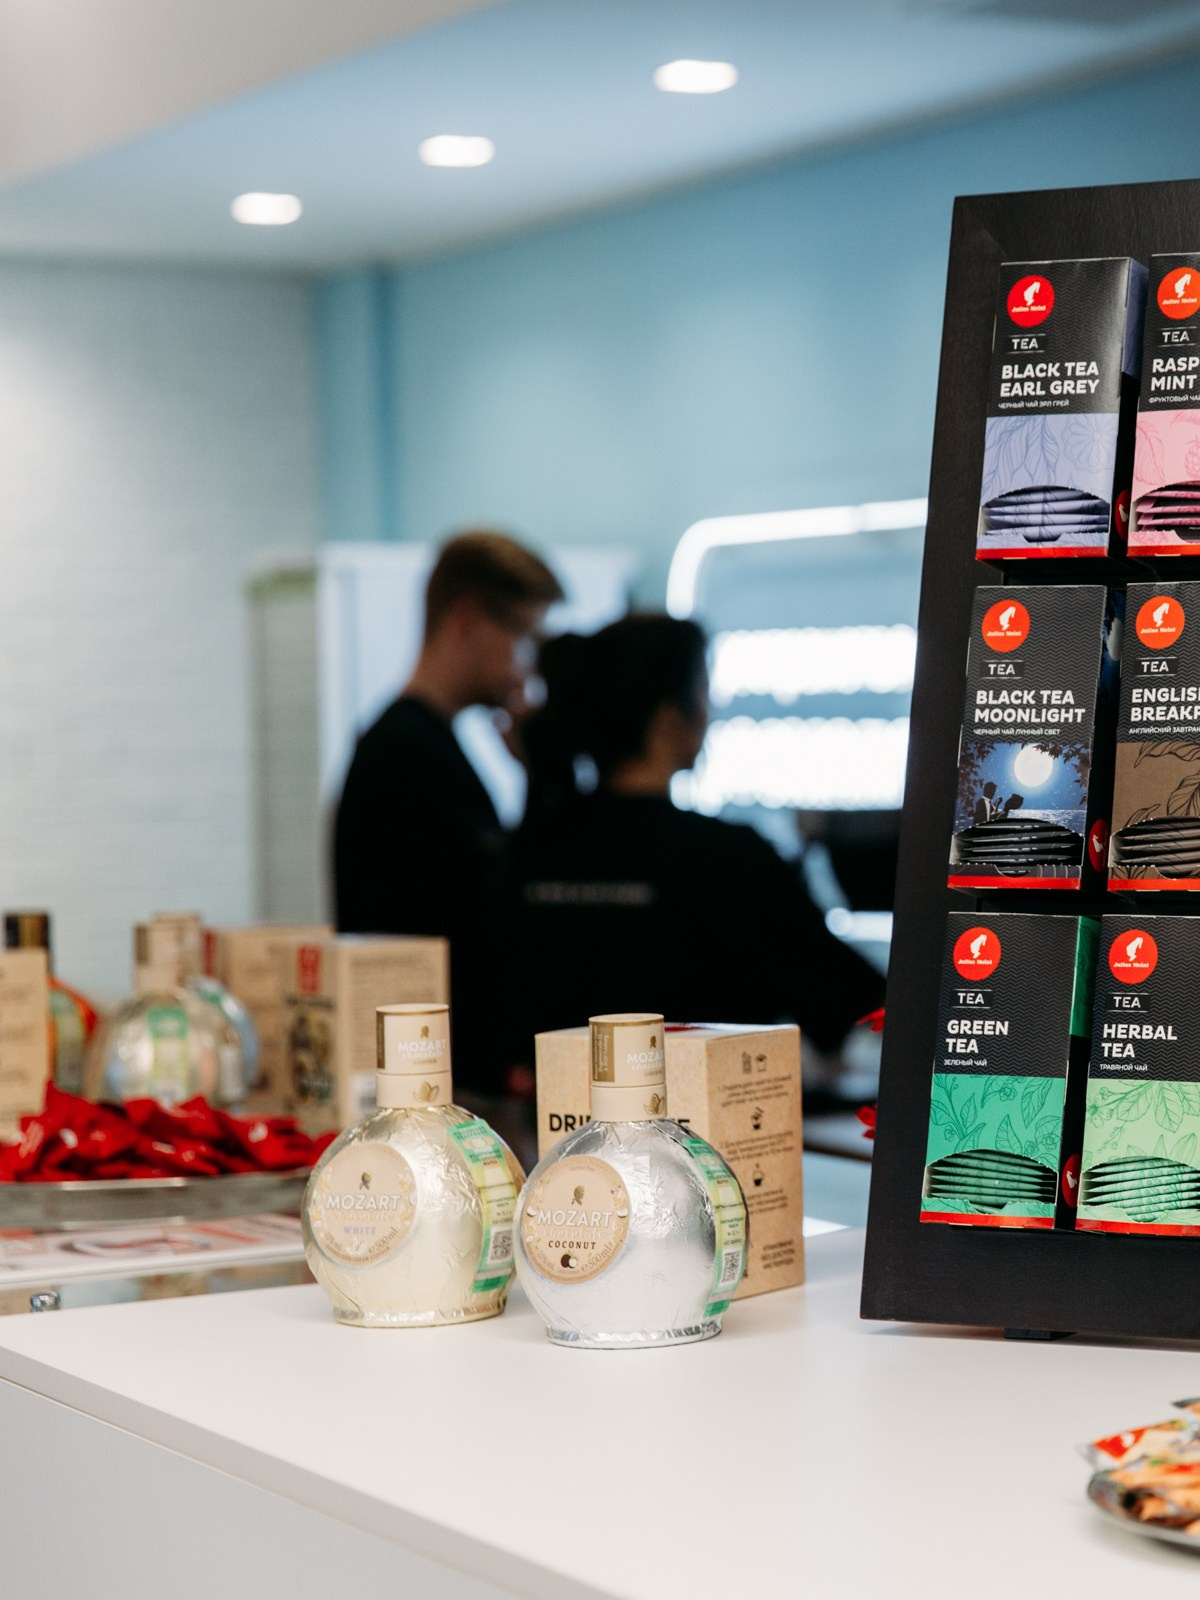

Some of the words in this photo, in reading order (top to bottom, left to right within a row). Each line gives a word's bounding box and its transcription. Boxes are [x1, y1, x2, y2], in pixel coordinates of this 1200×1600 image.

[1162, 331, 1190, 343] TEA
[1012, 338, 1039, 350] TEA
[1001, 362, 1061, 379] BLACK
[1064, 361, 1099, 376] TEA
[1000, 380, 1046, 397] EARL
[1049, 379, 1100, 394] GREY
[1151, 375, 1197, 391] MINT
[998, 401, 1025, 409] ЧЕРНЫЙ
[1026, 400, 1039, 408] ЧАЙ
[1052, 399, 1070, 407] ГРЕЙ
[1149, 394, 1189, 403] ФРУКТОВЫЙ
[988, 664, 1015, 675] TEA
[1141, 661, 1169, 673] TEA
[976, 690, 1036, 705] BLACK
[1040, 690, 1075, 705] TEA
[974, 708, 1086, 723] MOONLIGHT
[1128, 726, 1172, 734] АНГЛИЙСКИЙ
[957, 993, 985, 1005] TEA
[1113, 996, 1141, 1008] TEA
[947, 1020, 1009, 1036] GREEN
[1103, 1024, 1178, 1040] HERBAL
[945, 1038, 979, 1054] TEA
[1101, 1043, 1135, 1058] TEA
[627, 1052, 663, 1063] MOZA
[944, 1058, 974, 1066] ЗЕЛЕНЫЙ
[974, 1058, 987, 1067] ЧАЙ
[1100, 1063, 1133, 1071] ТРАВЯНОЙ
[1134, 1063, 1148, 1071] ЧАЙ
[549, 1114, 591, 1132] DRI
[325, 1194, 401, 1211] MOZART
[537, 1210, 613, 1228] MOZART
[344, 1226, 377, 1235] WHITE
[548, 1240, 597, 1250] COCONUT
